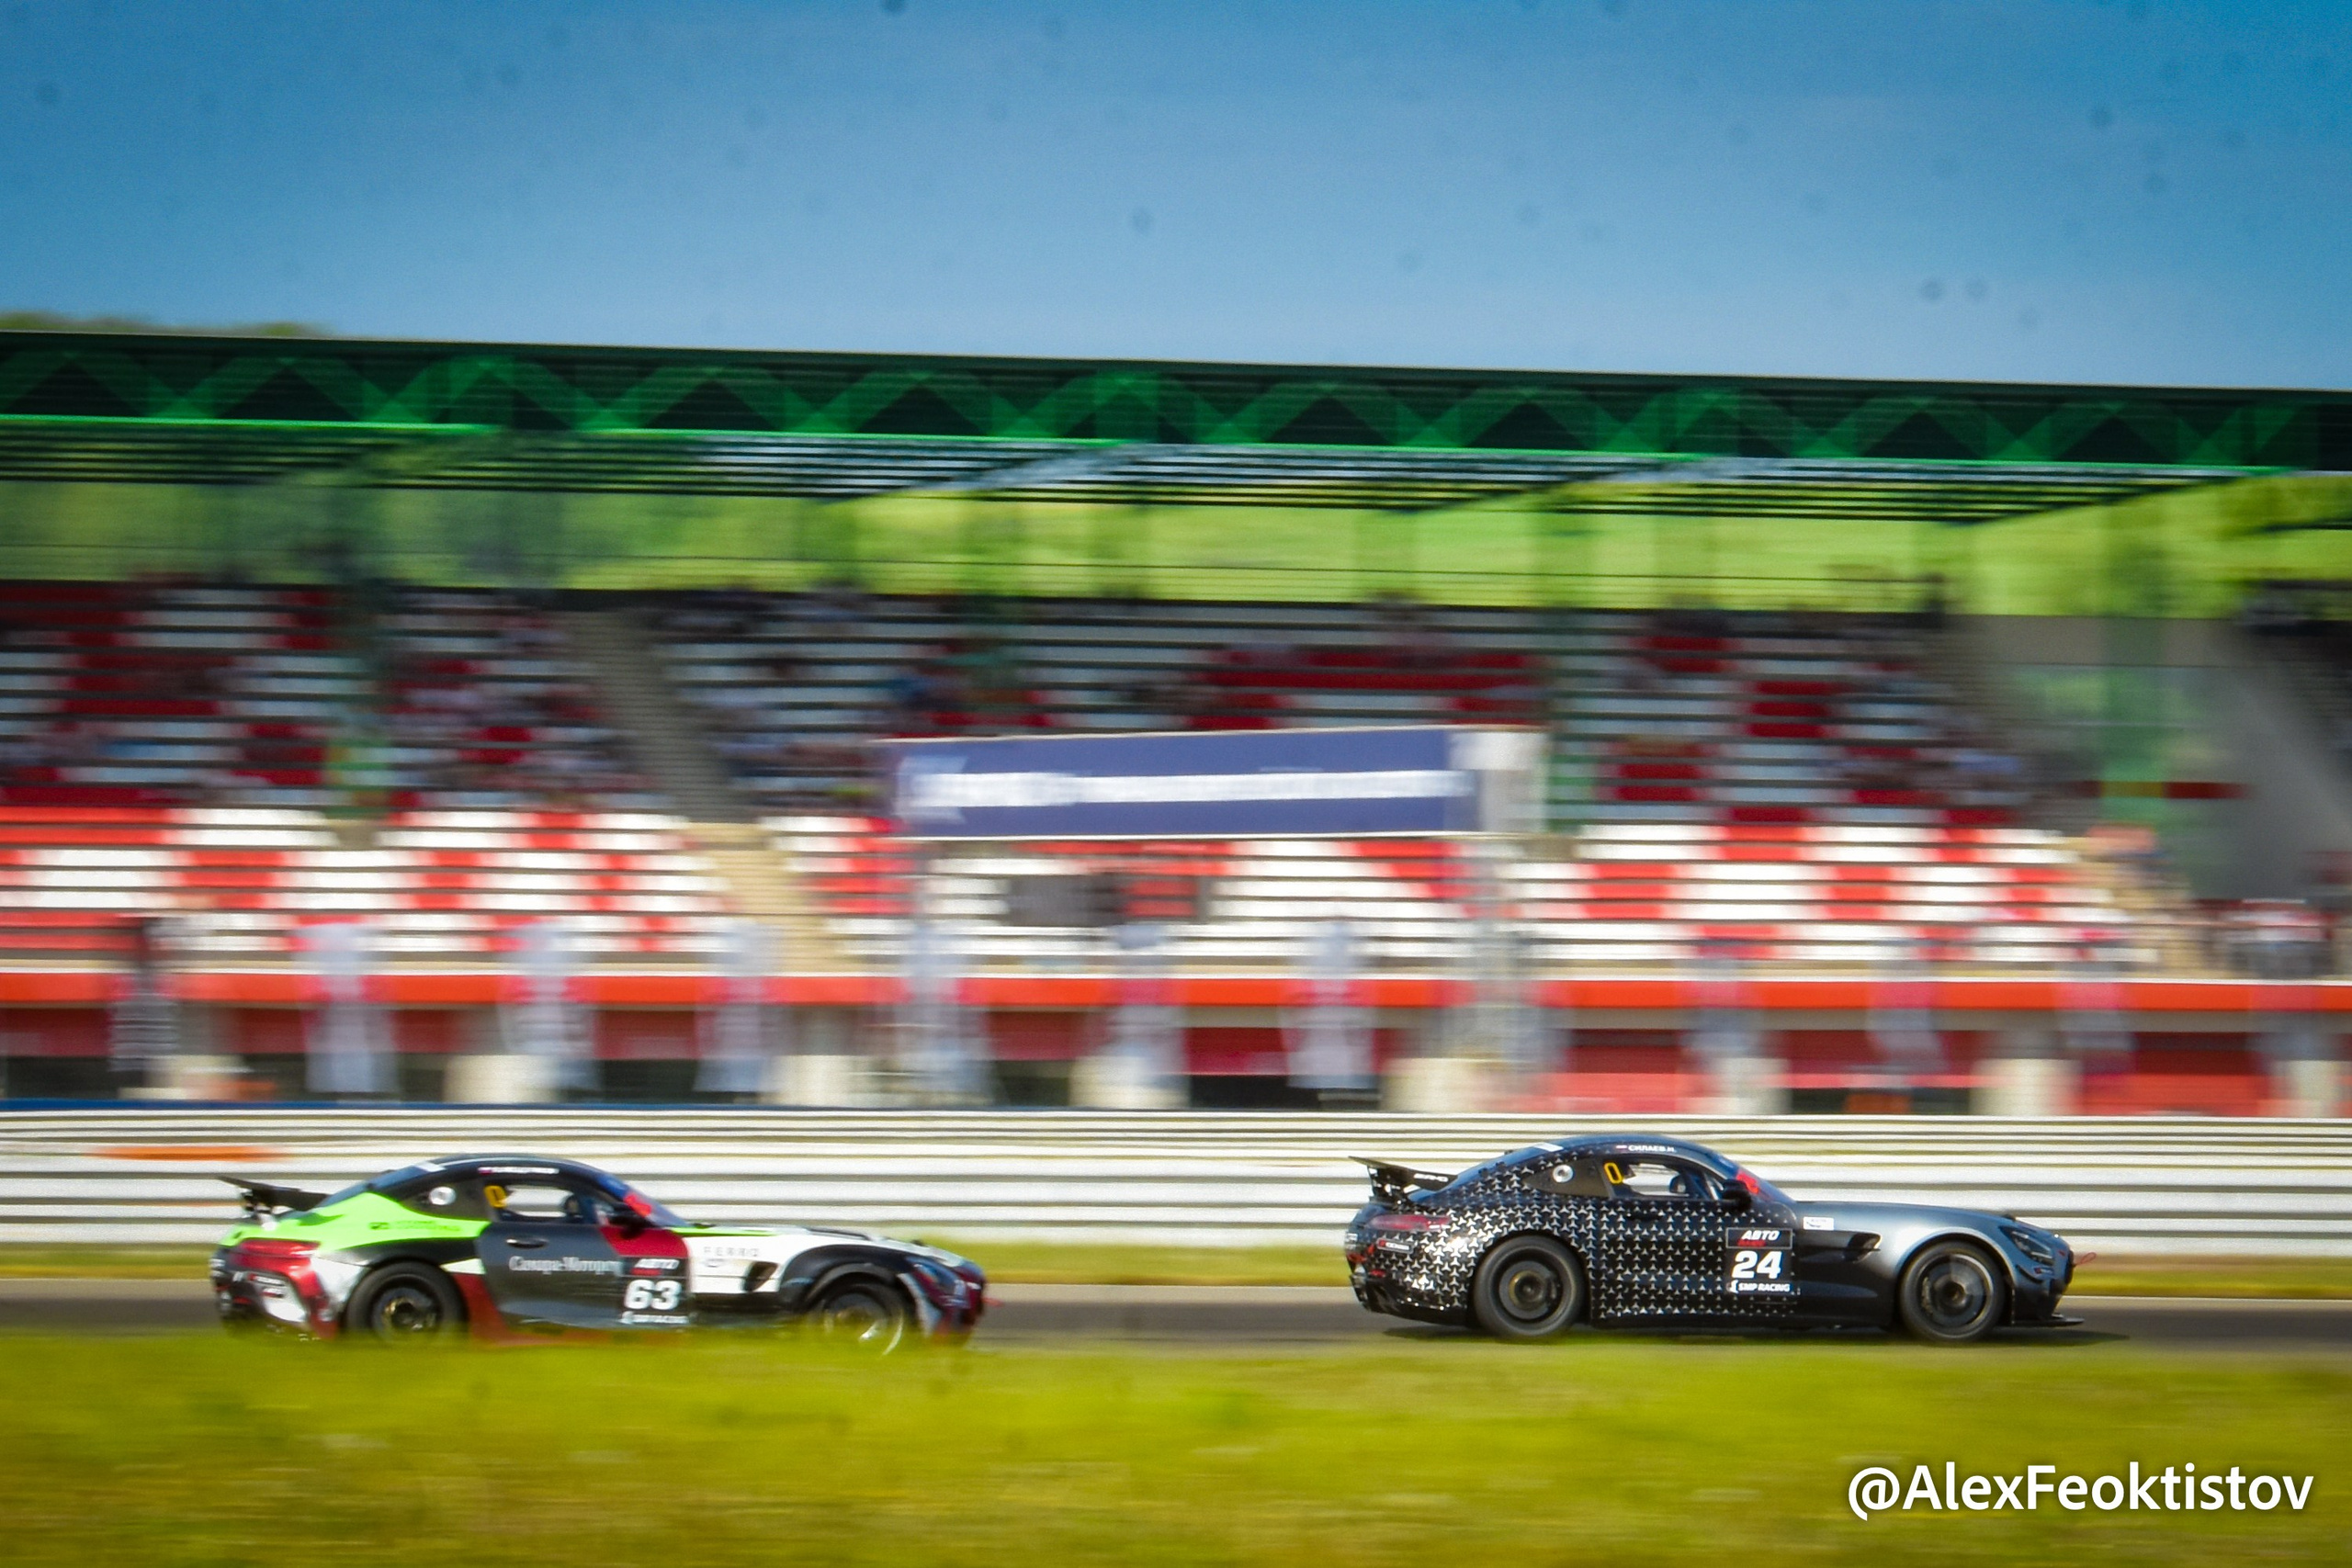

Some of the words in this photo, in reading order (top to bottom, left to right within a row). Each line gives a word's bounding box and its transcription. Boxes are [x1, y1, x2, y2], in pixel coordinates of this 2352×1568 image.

[1731, 1250, 1782, 1279] 24
[624, 1279, 682, 1310] 63
[1758, 1282, 1791, 1292] RACING
